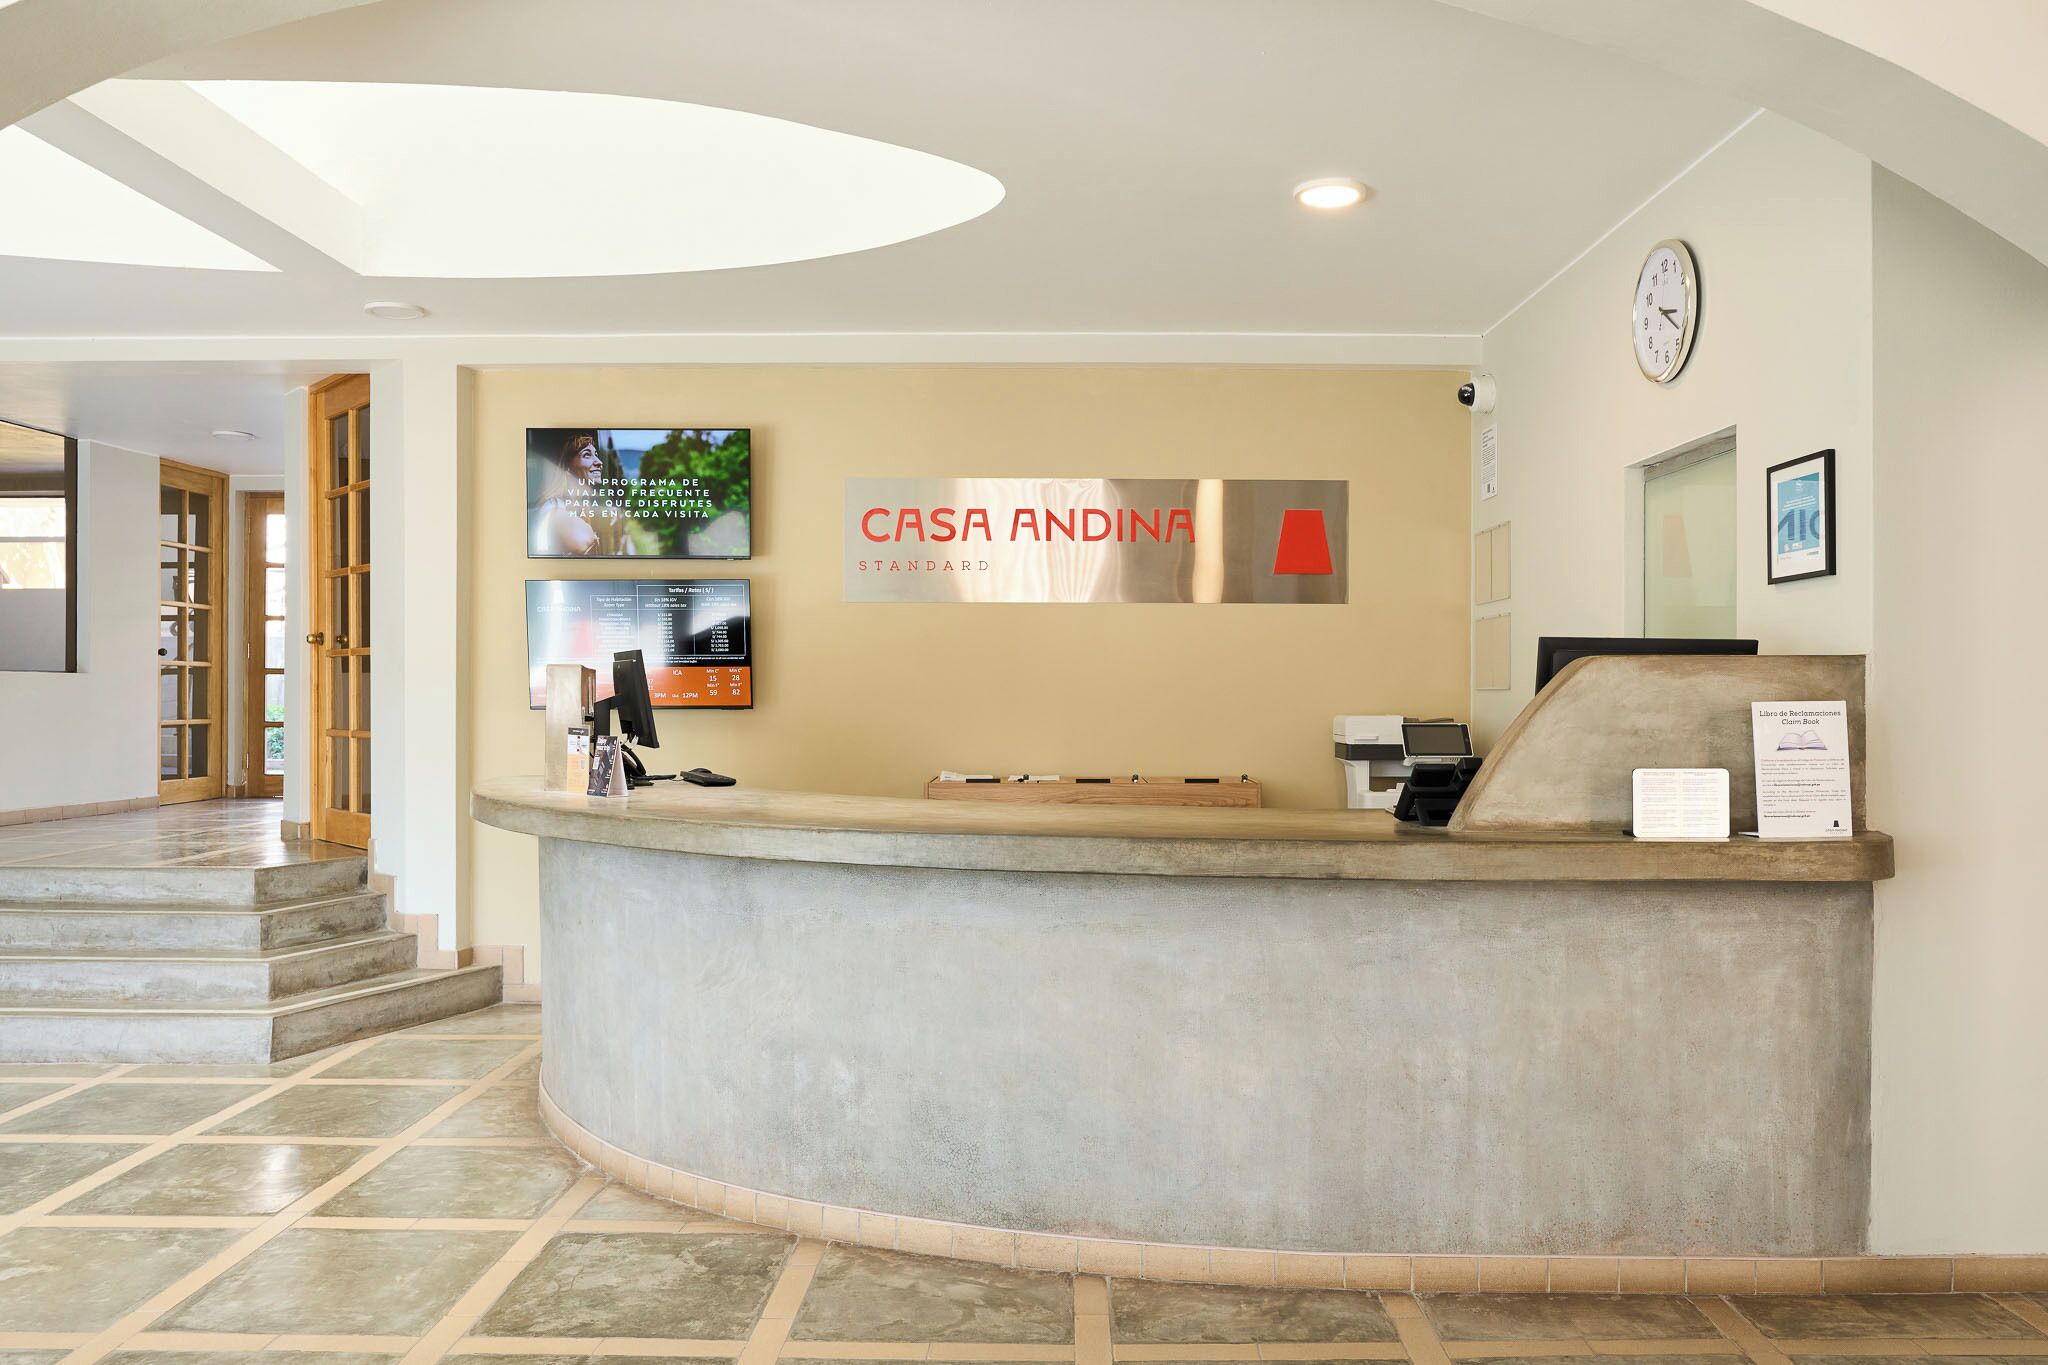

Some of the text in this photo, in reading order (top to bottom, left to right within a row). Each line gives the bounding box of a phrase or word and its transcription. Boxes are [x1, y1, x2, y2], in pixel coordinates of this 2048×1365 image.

[1661, 259, 1668, 273] 12
[1652, 273, 1658, 287] 11
[1680, 272, 1684, 285] 2
[1646, 292, 1652, 307] 10
[1644, 318, 1648, 330] 9
[1648, 336, 1653, 350] 8
[1654, 350, 1658, 364] 7
[1664, 350, 1670, 364] 6
[602, 478, 676, 486] PROGRAMA
[682, 478, 699, 486] DE
[606, 500, 632, 508] QUE
[638, 500, 713, 508] DISFRUTES
[569, 508, 595, 518] MÁS
[624, 510, 659, 518] CADA
[665, 510, 709, 518] VISITA
[861, 507, 1196, 543] CASA ANDINA
[858, 560, 990, 571] STANDARD
